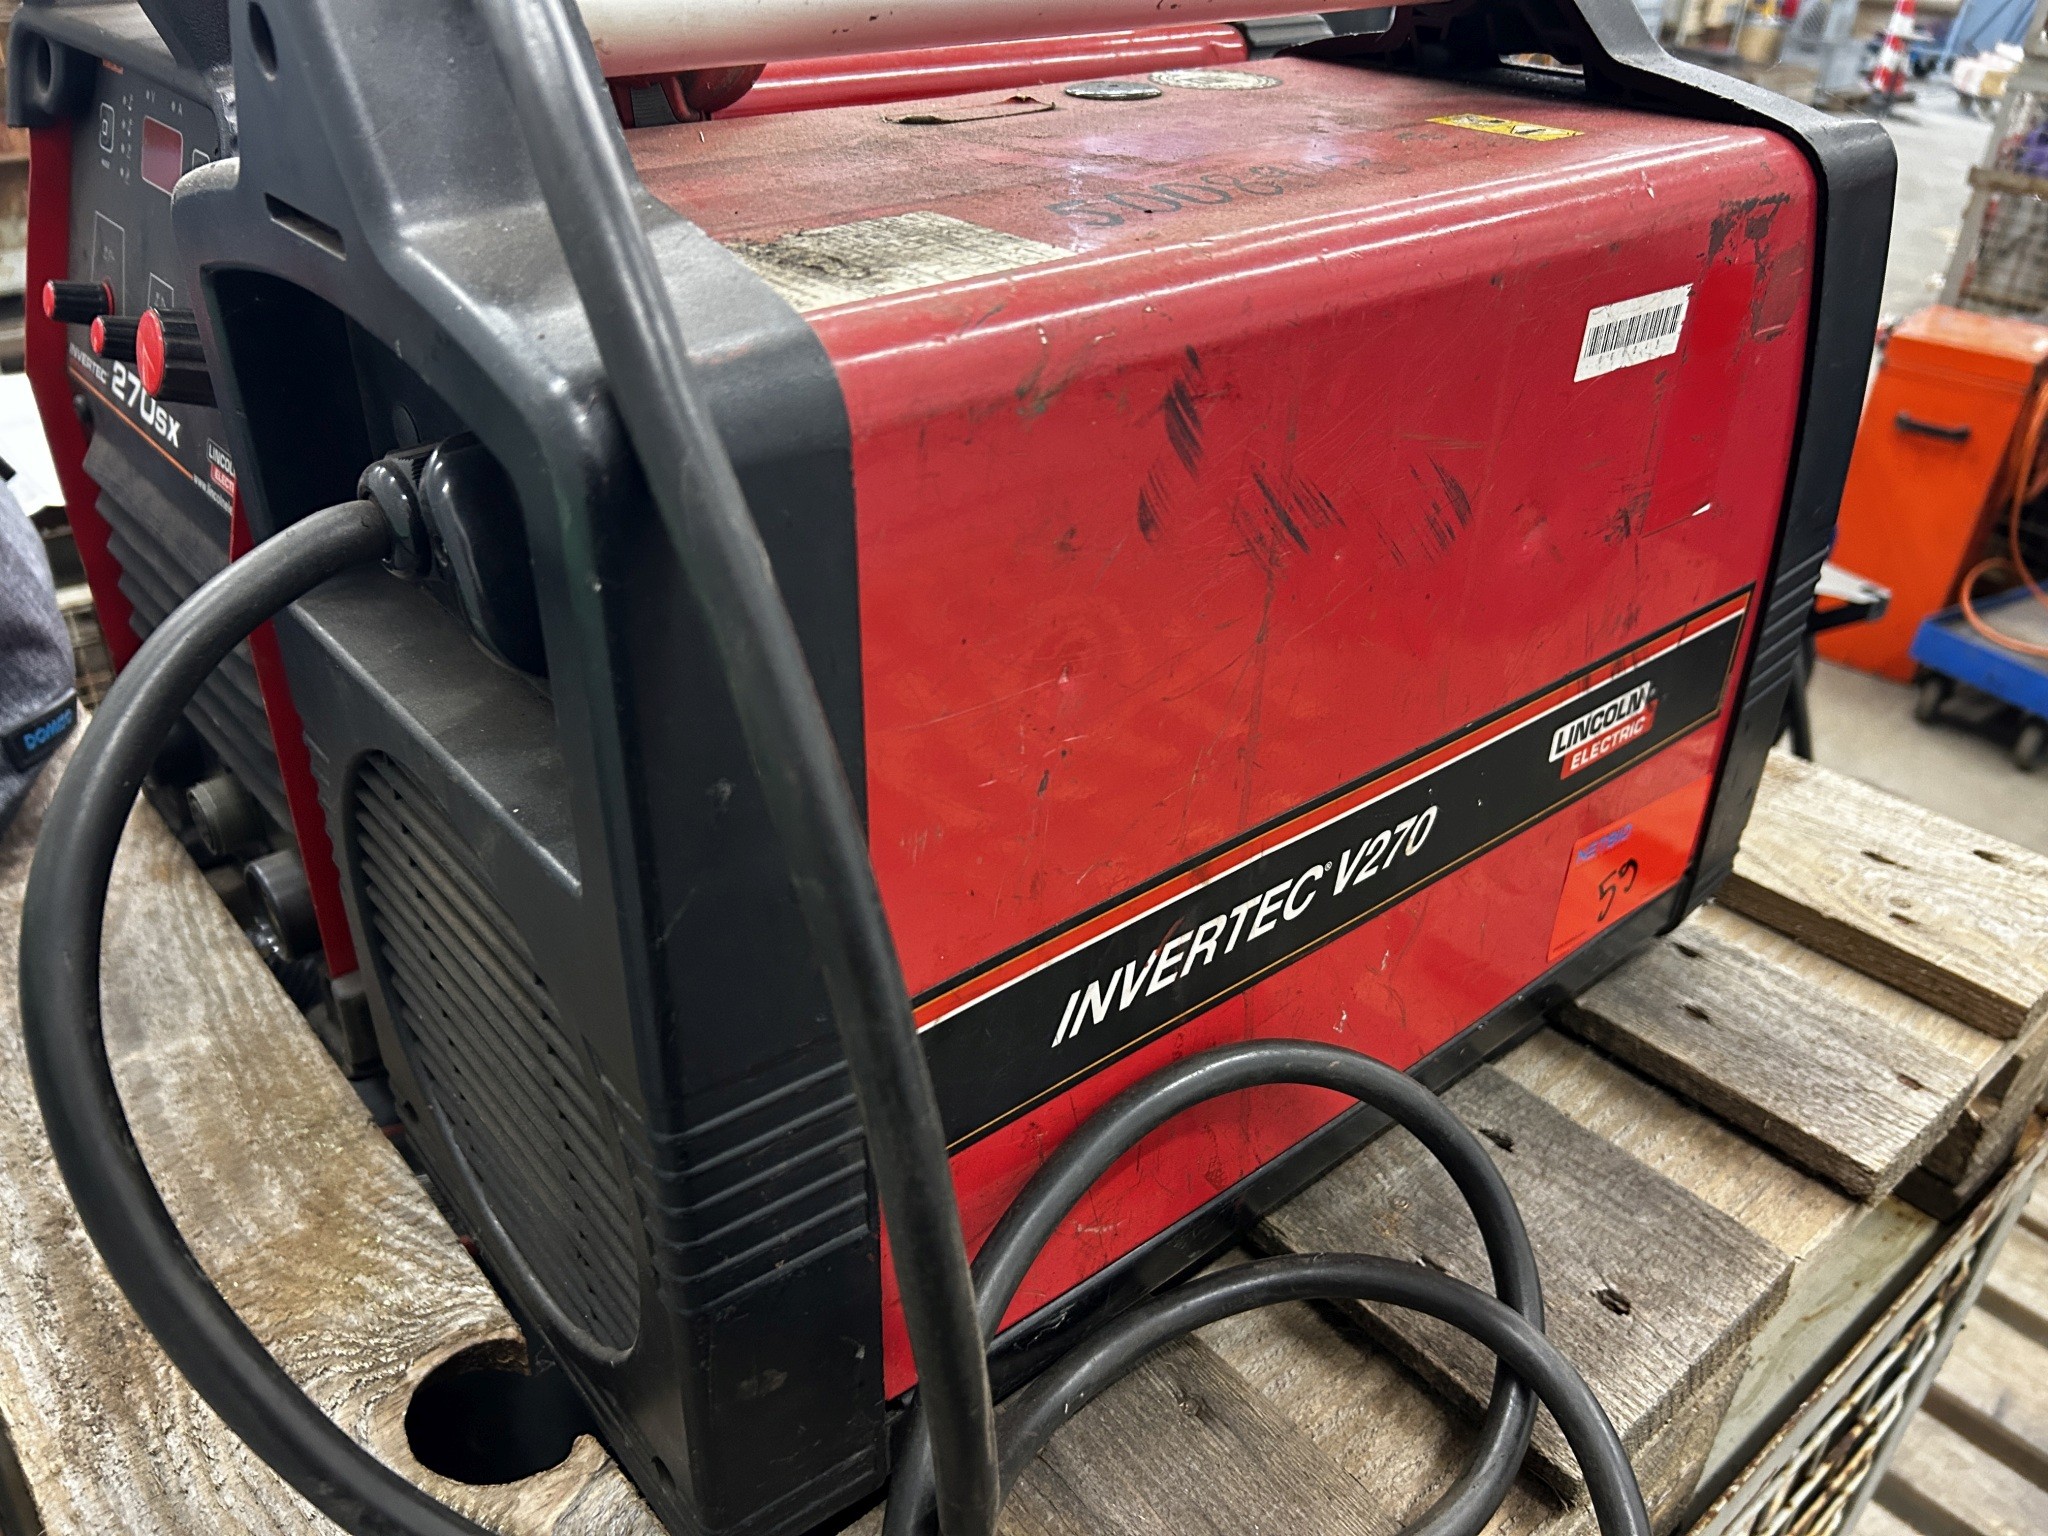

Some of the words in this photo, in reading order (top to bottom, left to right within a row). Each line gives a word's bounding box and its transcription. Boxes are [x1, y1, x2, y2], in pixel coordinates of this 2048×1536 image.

[208, 443, 236, 478] LINCOL
[1554, 686, 1647, 756] LINCOLN
[1569, 715, 1647, 772] ELECTRIC
[1332, 804, 1438, 897] V270
